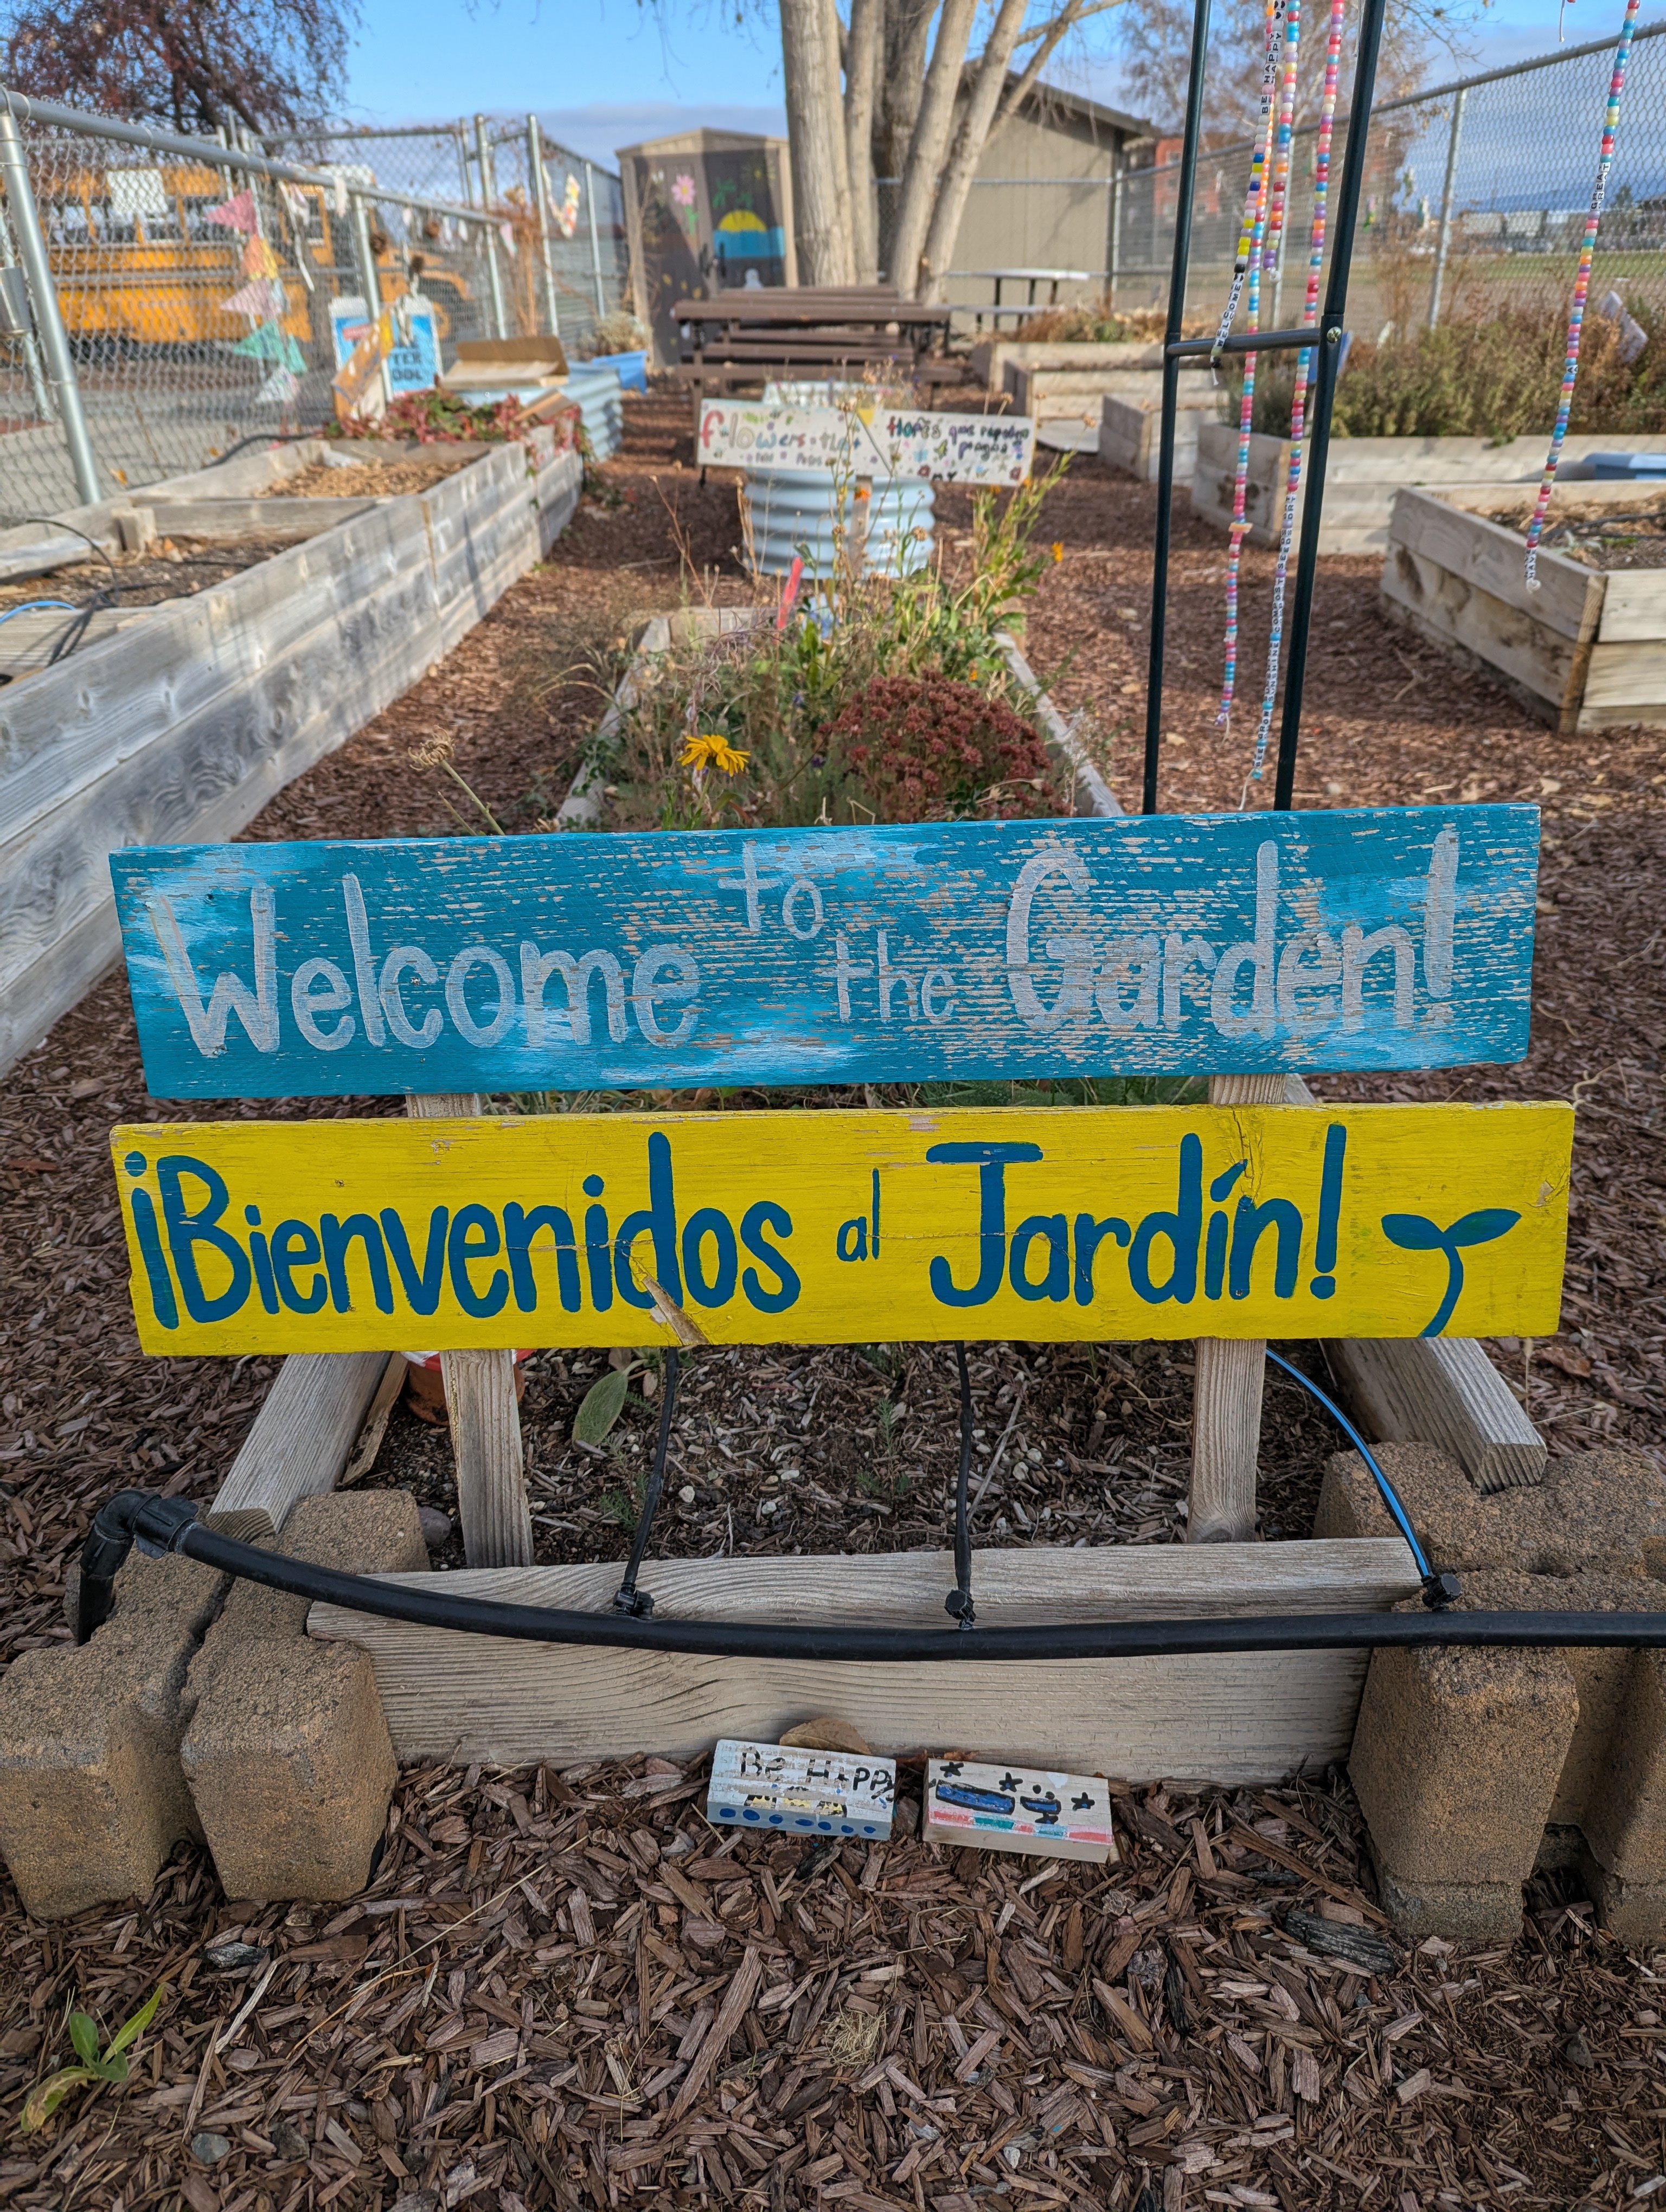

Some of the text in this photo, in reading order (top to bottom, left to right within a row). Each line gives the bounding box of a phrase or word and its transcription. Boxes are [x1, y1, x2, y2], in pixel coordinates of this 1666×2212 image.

[1264, 33, 1281, 83] HAPPY
[1591, 164, 1609, 209] GREAT
[1214, 284, 1241, 346] WELCOME
[1278, 529, 1292, 569] SEEDS
[1273, 578, 1284, 633] COMPOST
[1265, 642, 1279, 702] SUNSHINE
[1258, 711, 1270, 738] GROW
[1254, 748, 1264, 767] BEE
[145, 829, 1459, 1057] Welcome to the Garden!
[125, 1121, 1347, 1329] ¡Bienvenidos al Jardín!
[741, 1746, 786, 1782] Be
